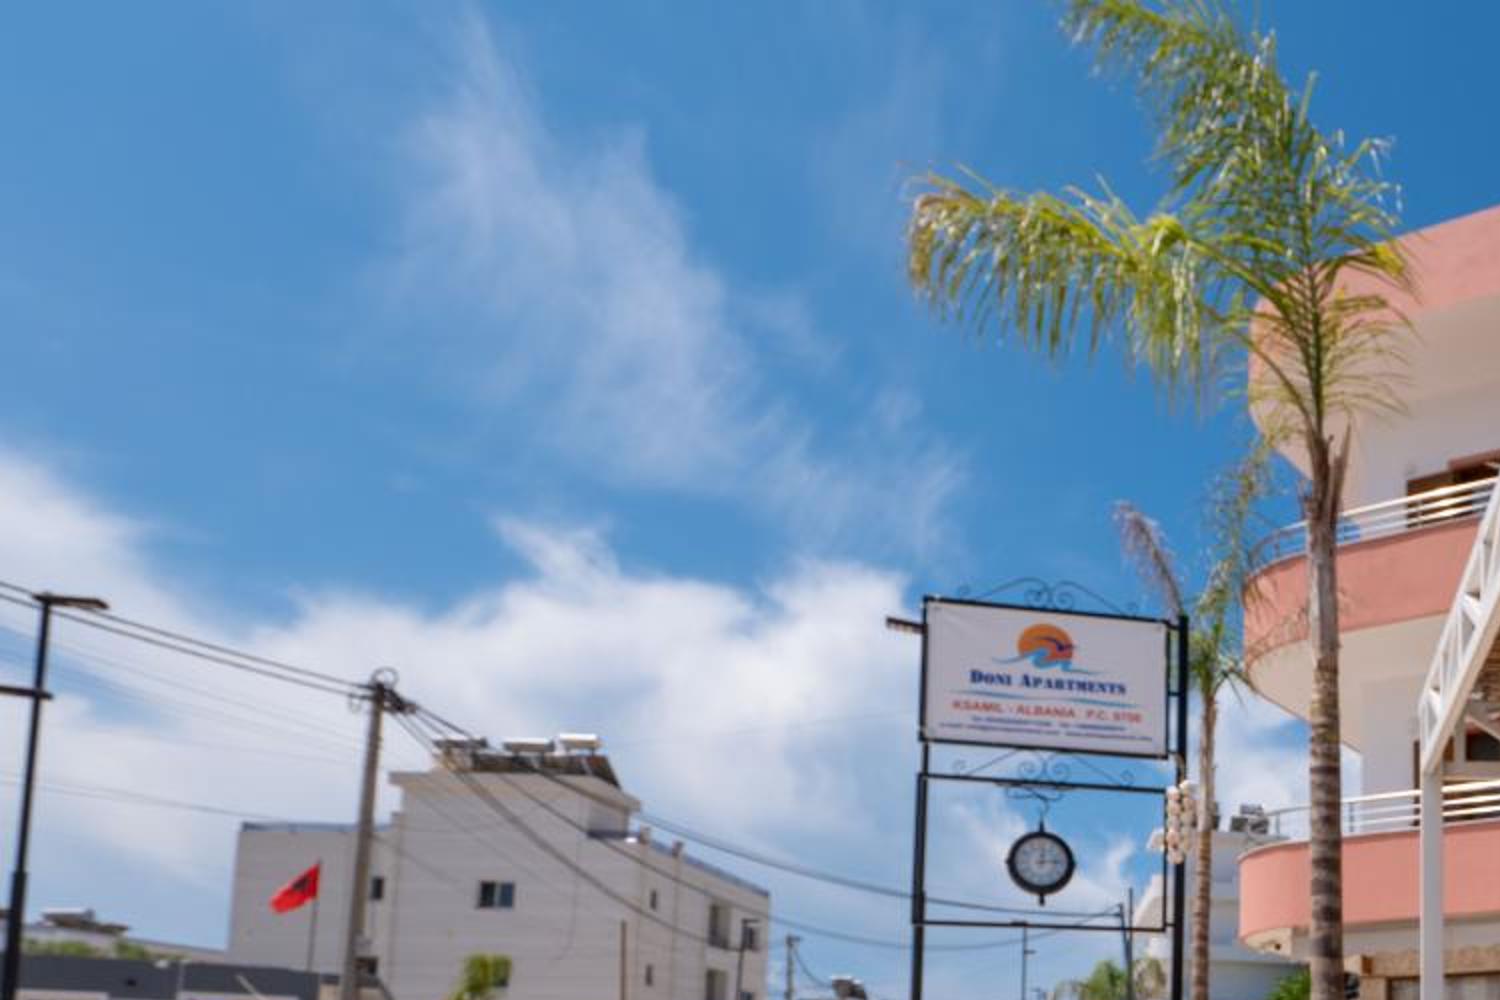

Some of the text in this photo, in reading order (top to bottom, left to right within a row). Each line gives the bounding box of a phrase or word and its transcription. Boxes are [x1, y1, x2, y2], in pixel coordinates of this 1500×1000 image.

[970, 669, 1126, 695] DONI APARTMENTS
[952, 699, 1003, 714] KSAMIL
[1016, 703, 1075, 719] ALBANIA
